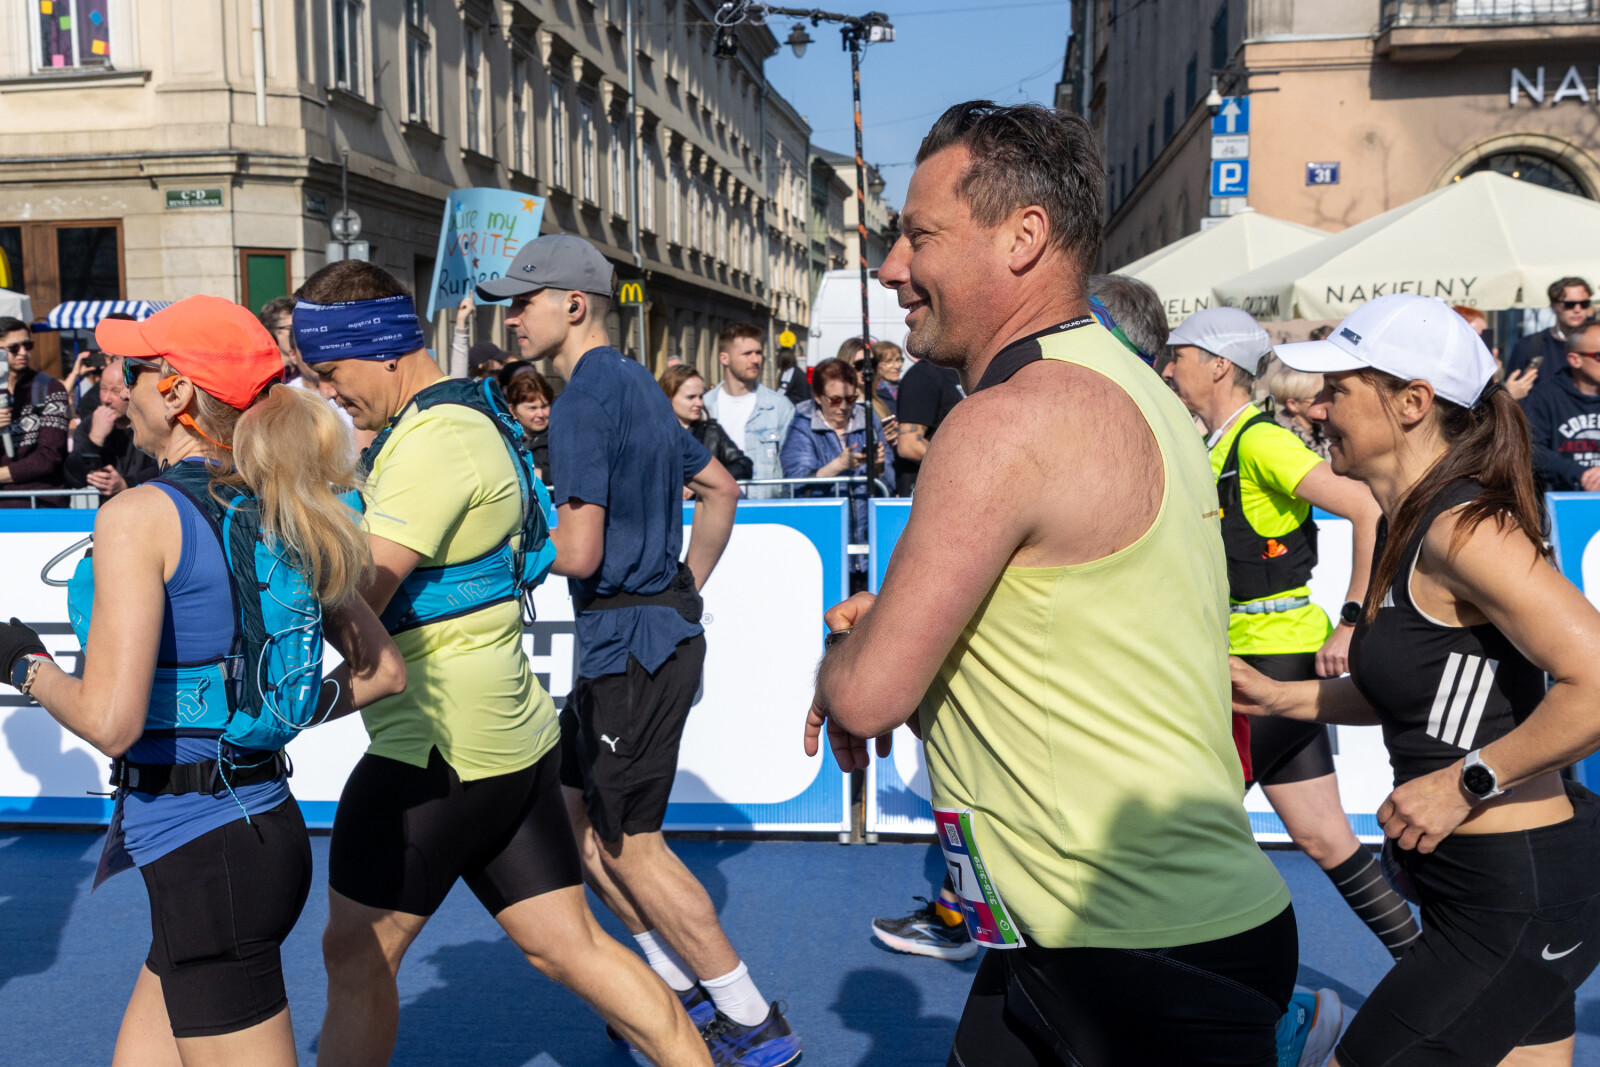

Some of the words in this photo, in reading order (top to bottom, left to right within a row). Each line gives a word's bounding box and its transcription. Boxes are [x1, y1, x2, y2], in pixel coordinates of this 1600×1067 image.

[1510, 65, 1600, 104] NA
[1314, 168, 1331, 183] 31
[487, 211, 518, 241] my
[1558, 413, 1600, 439] CORE
